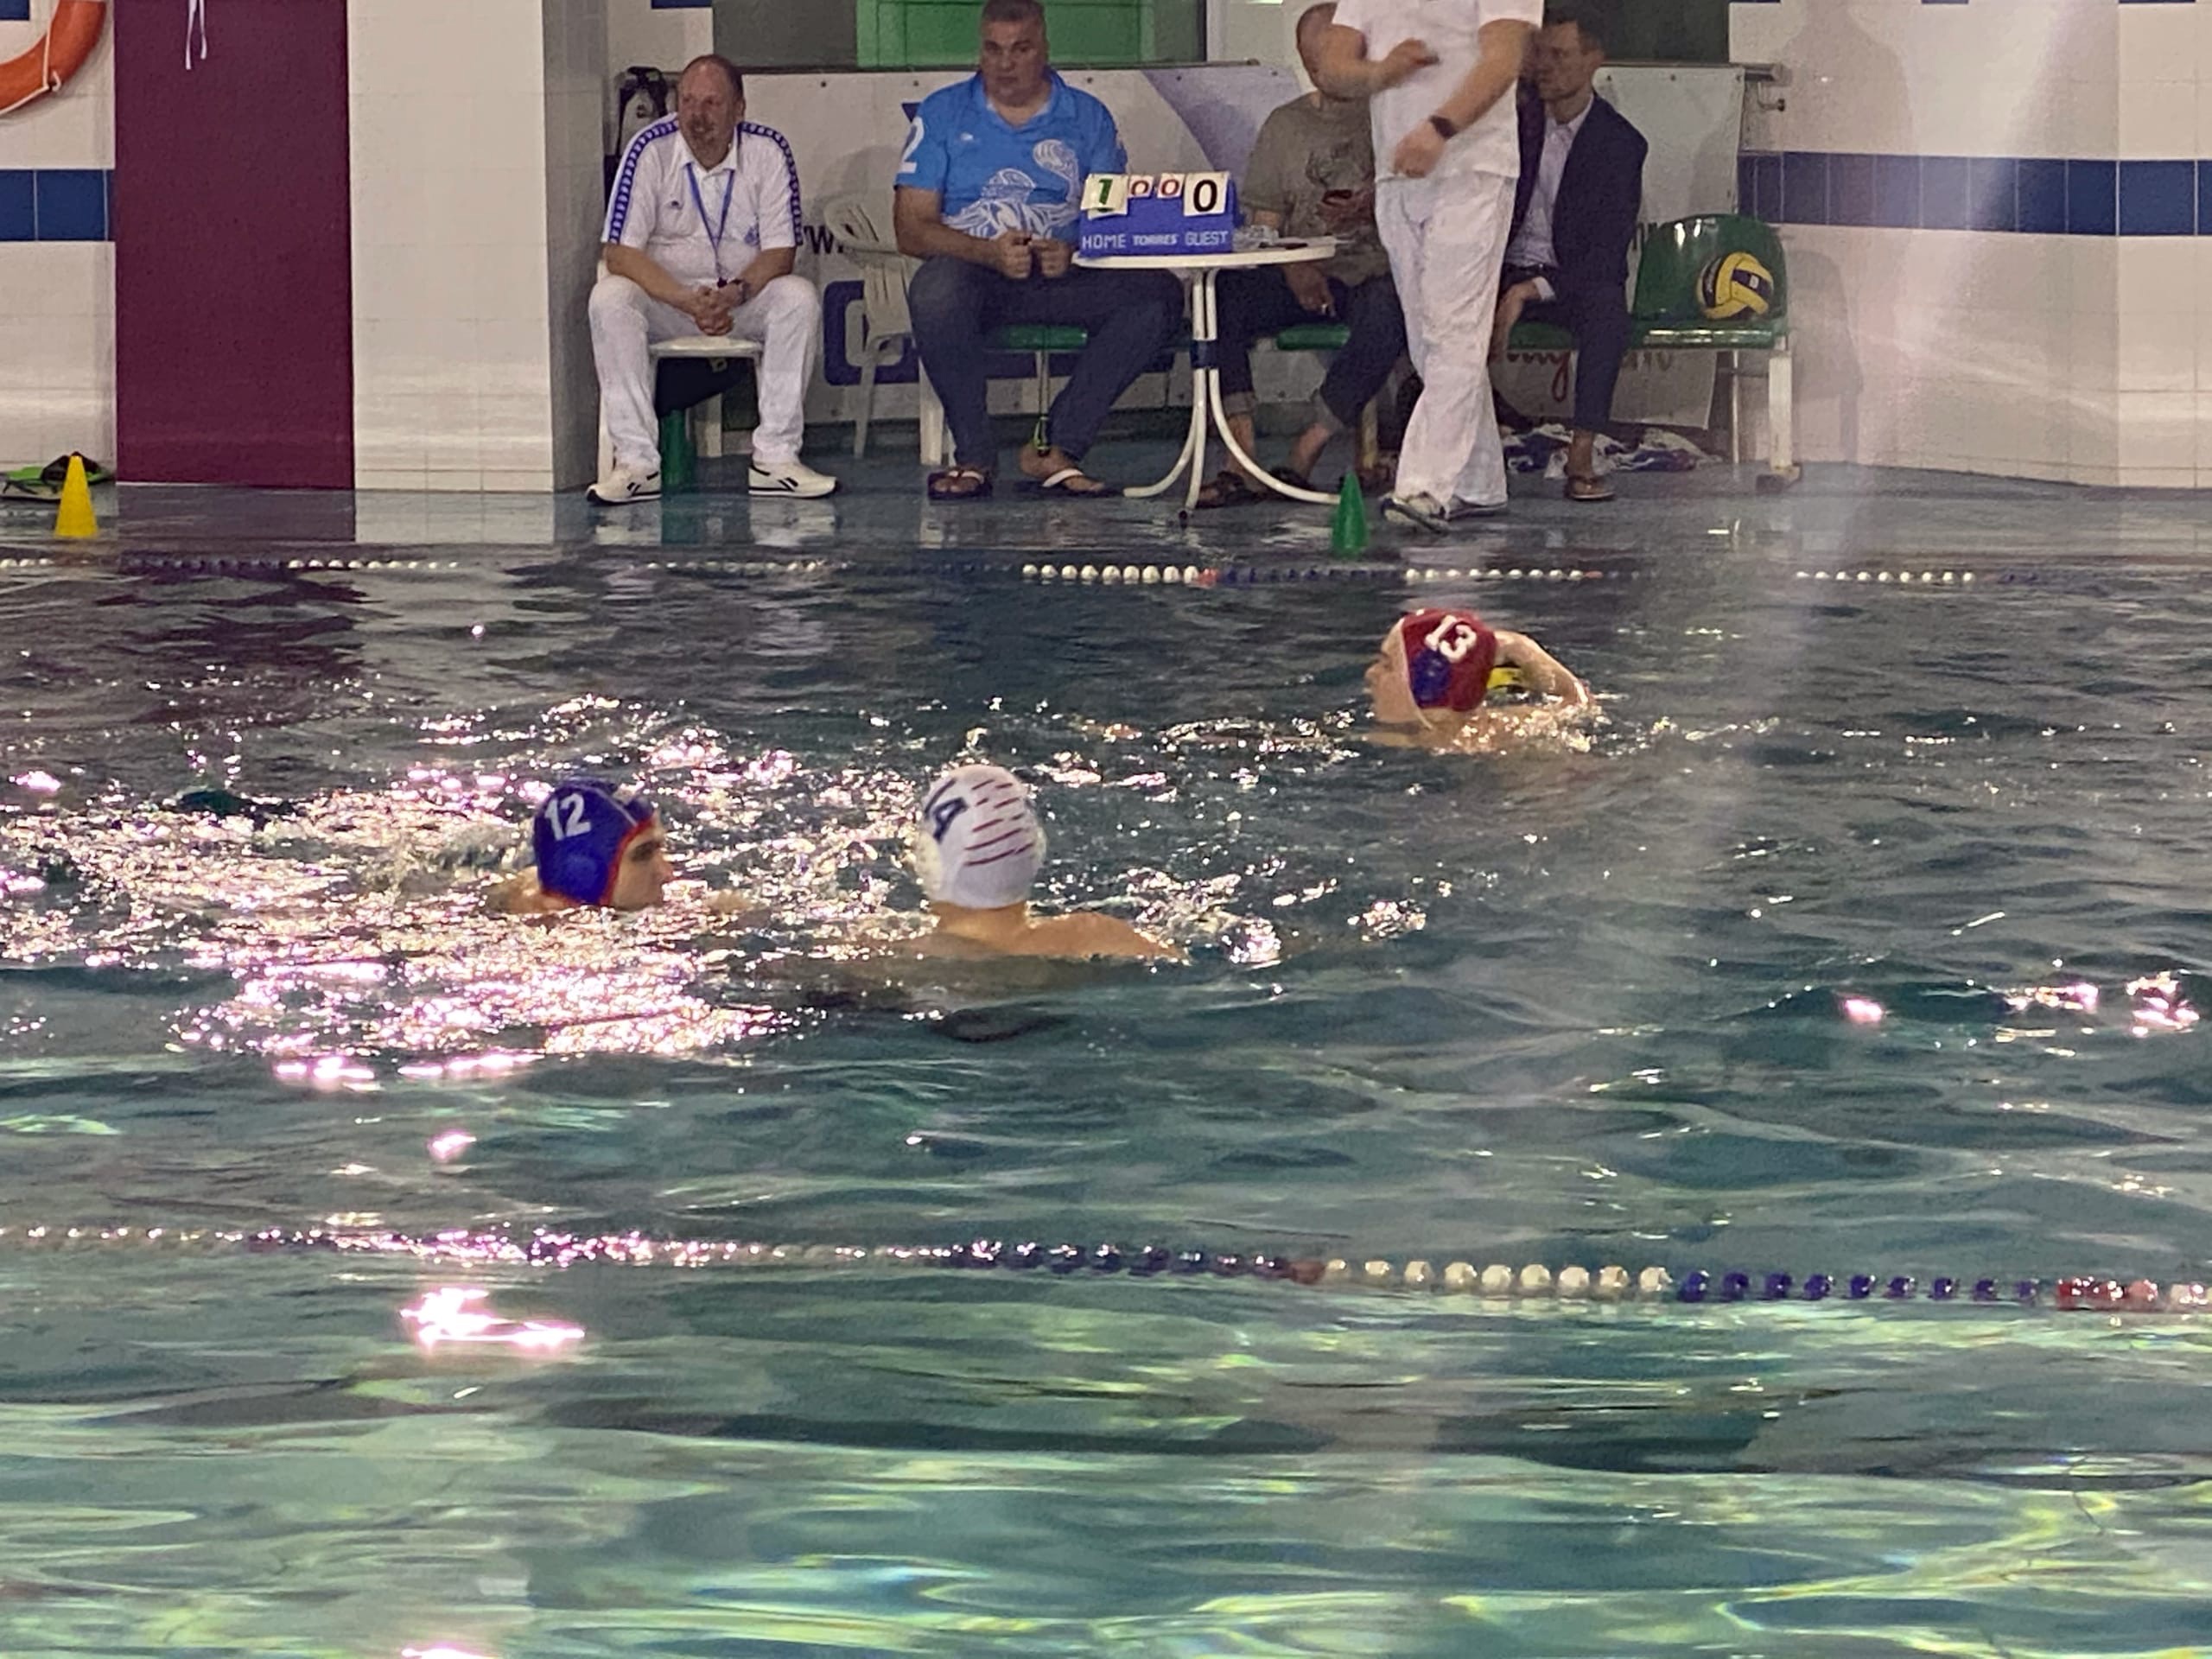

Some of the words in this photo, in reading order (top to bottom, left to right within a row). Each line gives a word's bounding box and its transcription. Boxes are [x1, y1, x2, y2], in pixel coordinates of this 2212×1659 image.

[1098, 178, 1113, 205] 1
[1193, 179, 1217, 213] 0
[1082, 233, 1127, 250] HOME
[1185, 230, 1229, 246] GUEST
[1424, 614, 1478, 664] 13
[544, 792, 592, 841] 12
